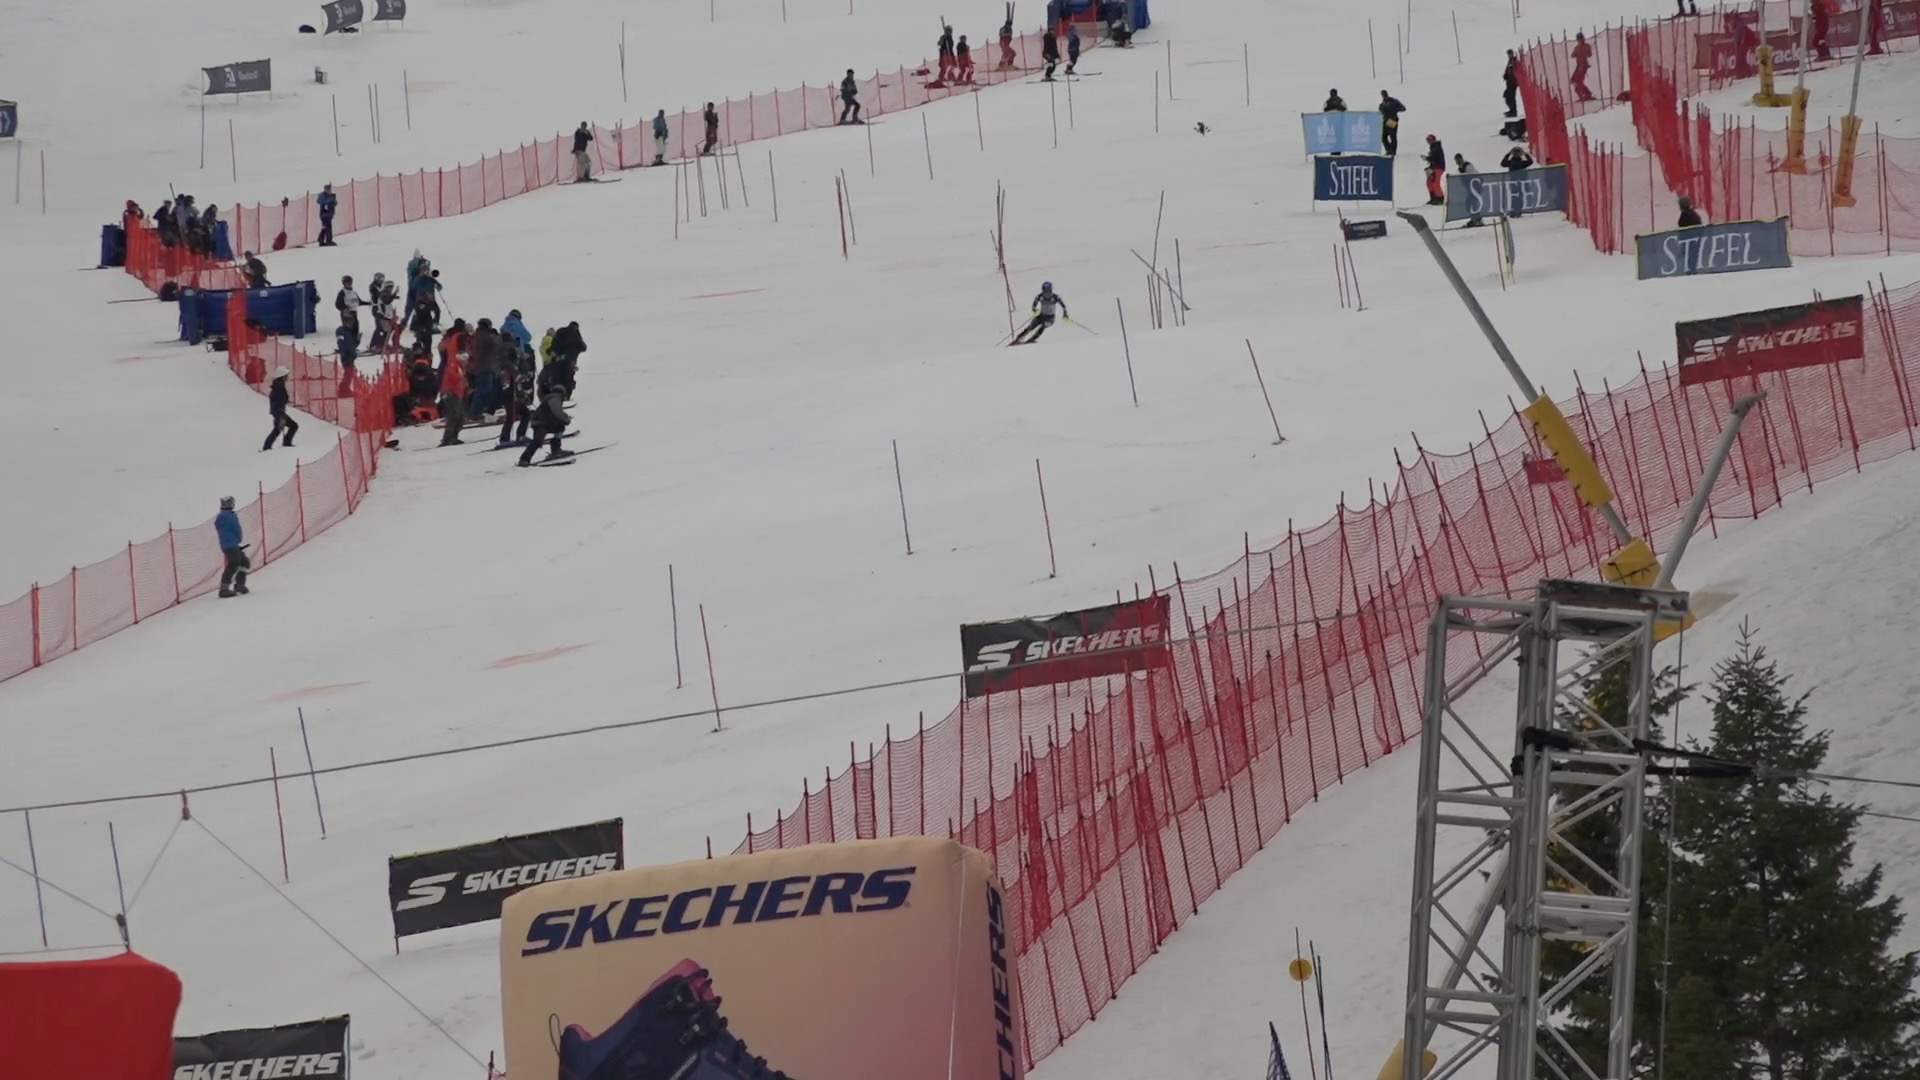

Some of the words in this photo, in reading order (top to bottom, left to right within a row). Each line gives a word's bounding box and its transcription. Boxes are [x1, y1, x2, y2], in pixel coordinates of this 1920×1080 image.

[1329, 161, 1379, 197] STIFEL
[1469, 178, 1549, 214] STIFEL
[1661, 232, 1760, 275] STIFEL
[1025, 624, 1160, 661] SKECHERS
[462, 852, 617, 895] SKECHERS
[521, 866, 915, 957] SKECHERS
[174, 1052, 342, 1080] SKECHERS
